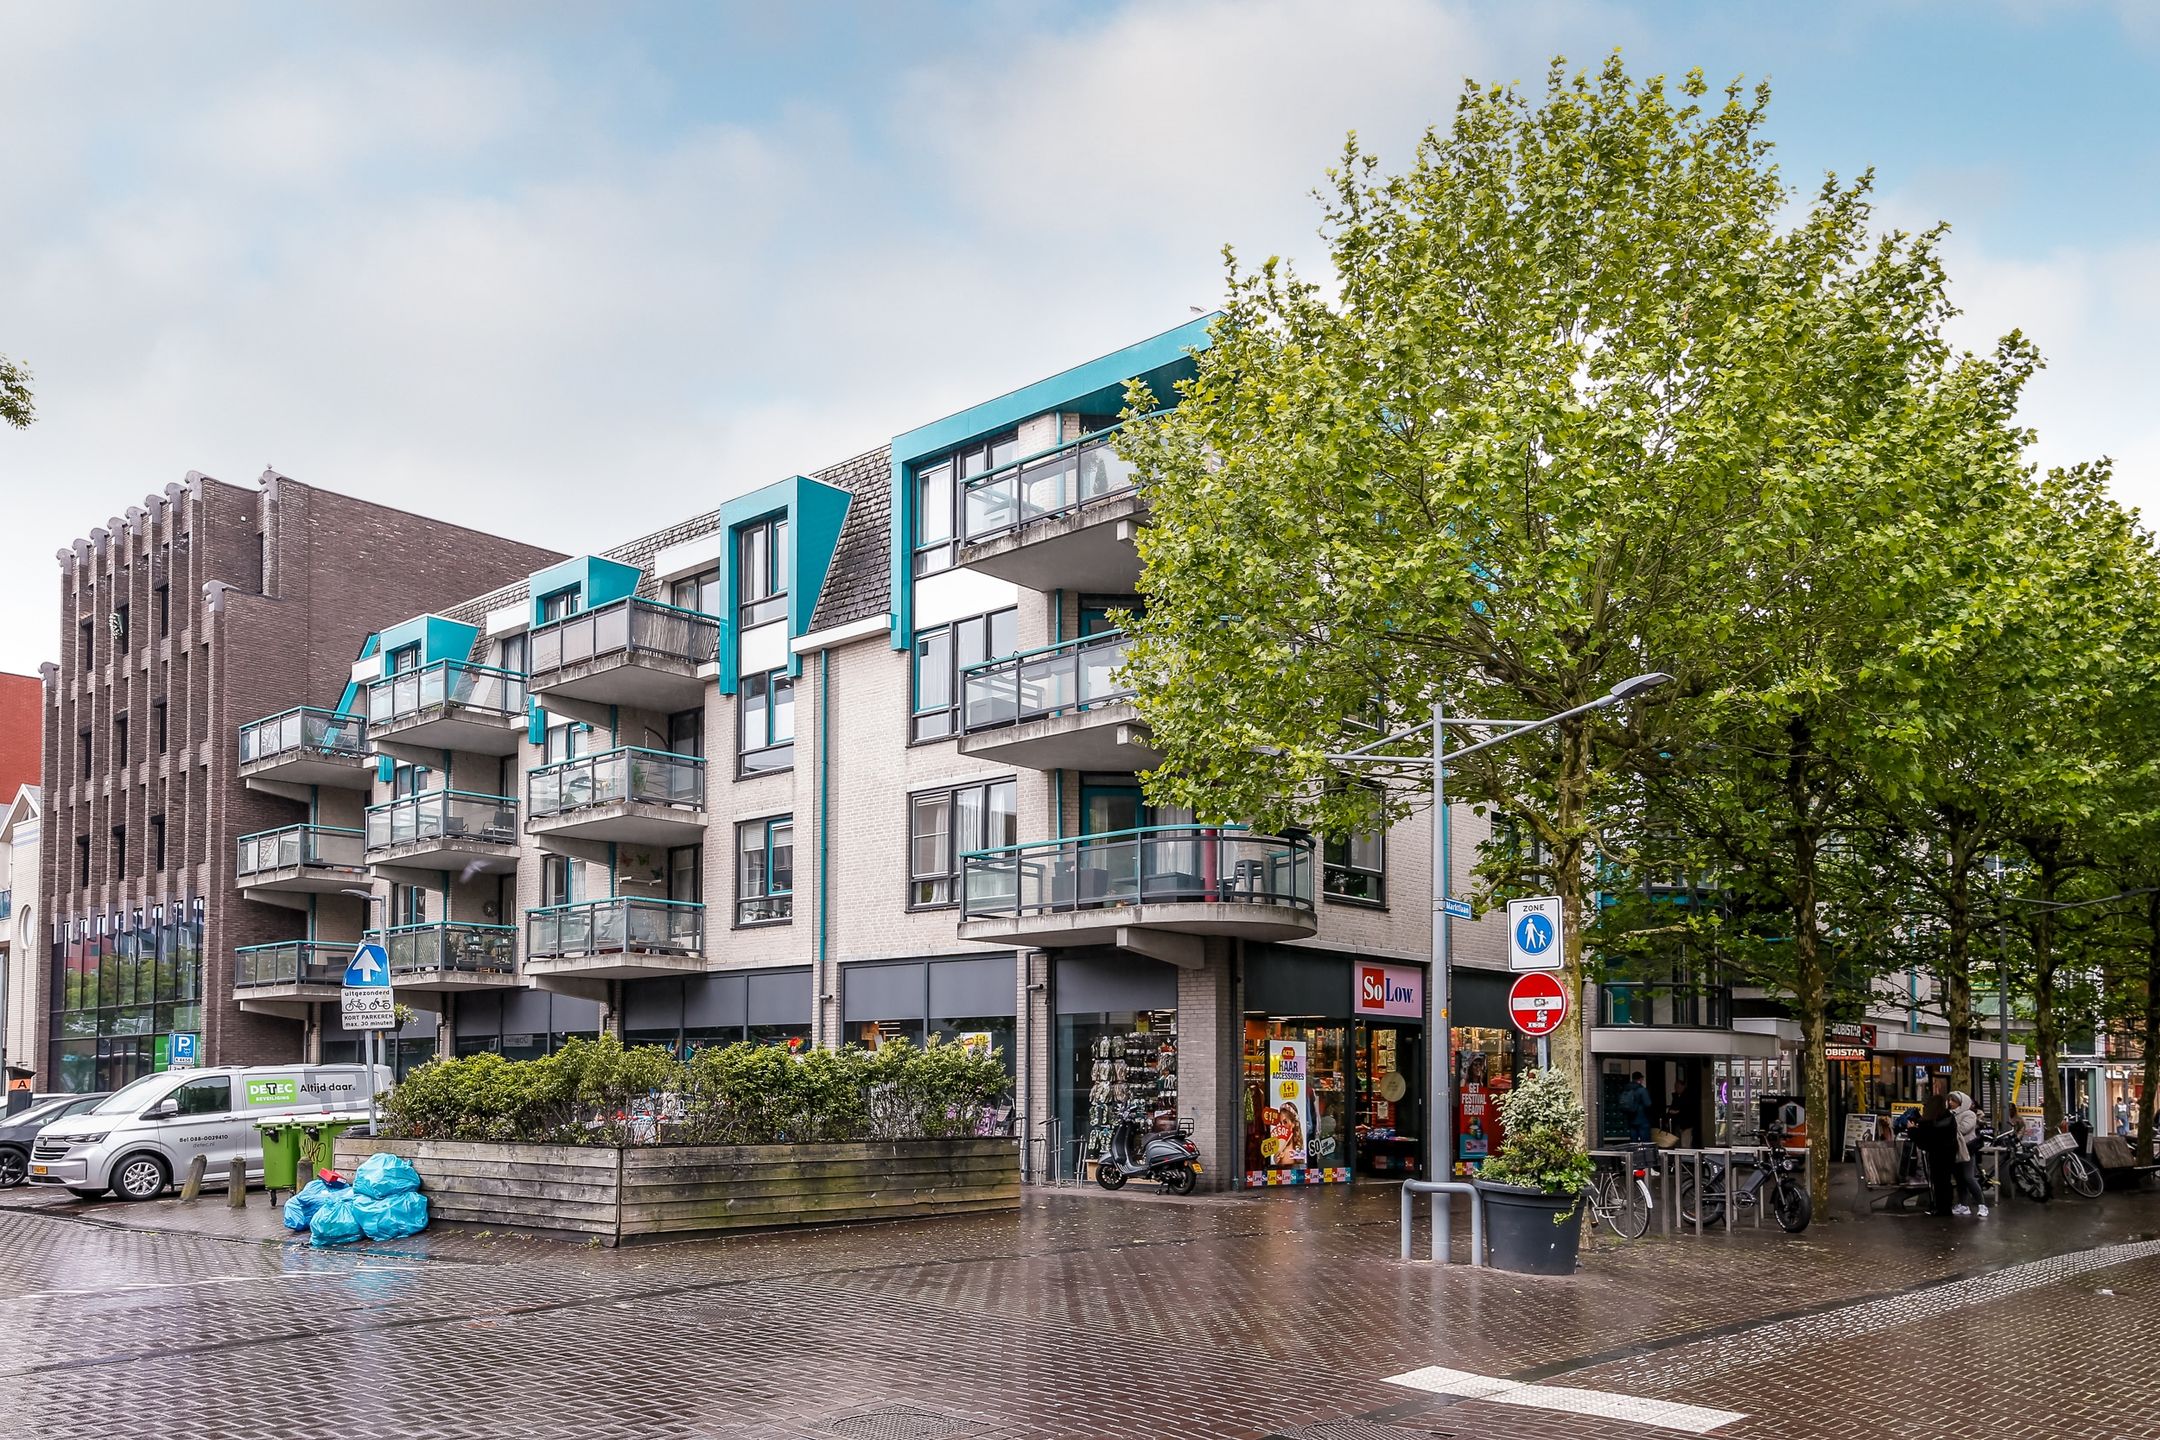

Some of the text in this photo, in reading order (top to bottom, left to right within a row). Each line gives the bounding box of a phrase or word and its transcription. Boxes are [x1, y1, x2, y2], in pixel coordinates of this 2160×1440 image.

[1446, 902, 1468, 913] Marktlaan
[1523, 904, 1544, 912] ZONE
[178, 1037, 191, 1052] P
[1825, 1048, 1865, 1057] OBISTAR
[1279, 1061, 1298, 1072] HAAR
[1272, 1072, 1304, 1080] ACCESSOIRES
[18, 1080, 27, 1088] A
[250, 1083, 356, 1095] DETEC Altijd daar.
[1283, 1082, 1294, 1092] 1+1
[1469, 1083, 1479, 1093] GET
[1461, 1094, 1486, 1104] FESTIVAL
[1464, 1105, 1485, 1115] READY!
[1309, 1140, 1320, 1155] SO
